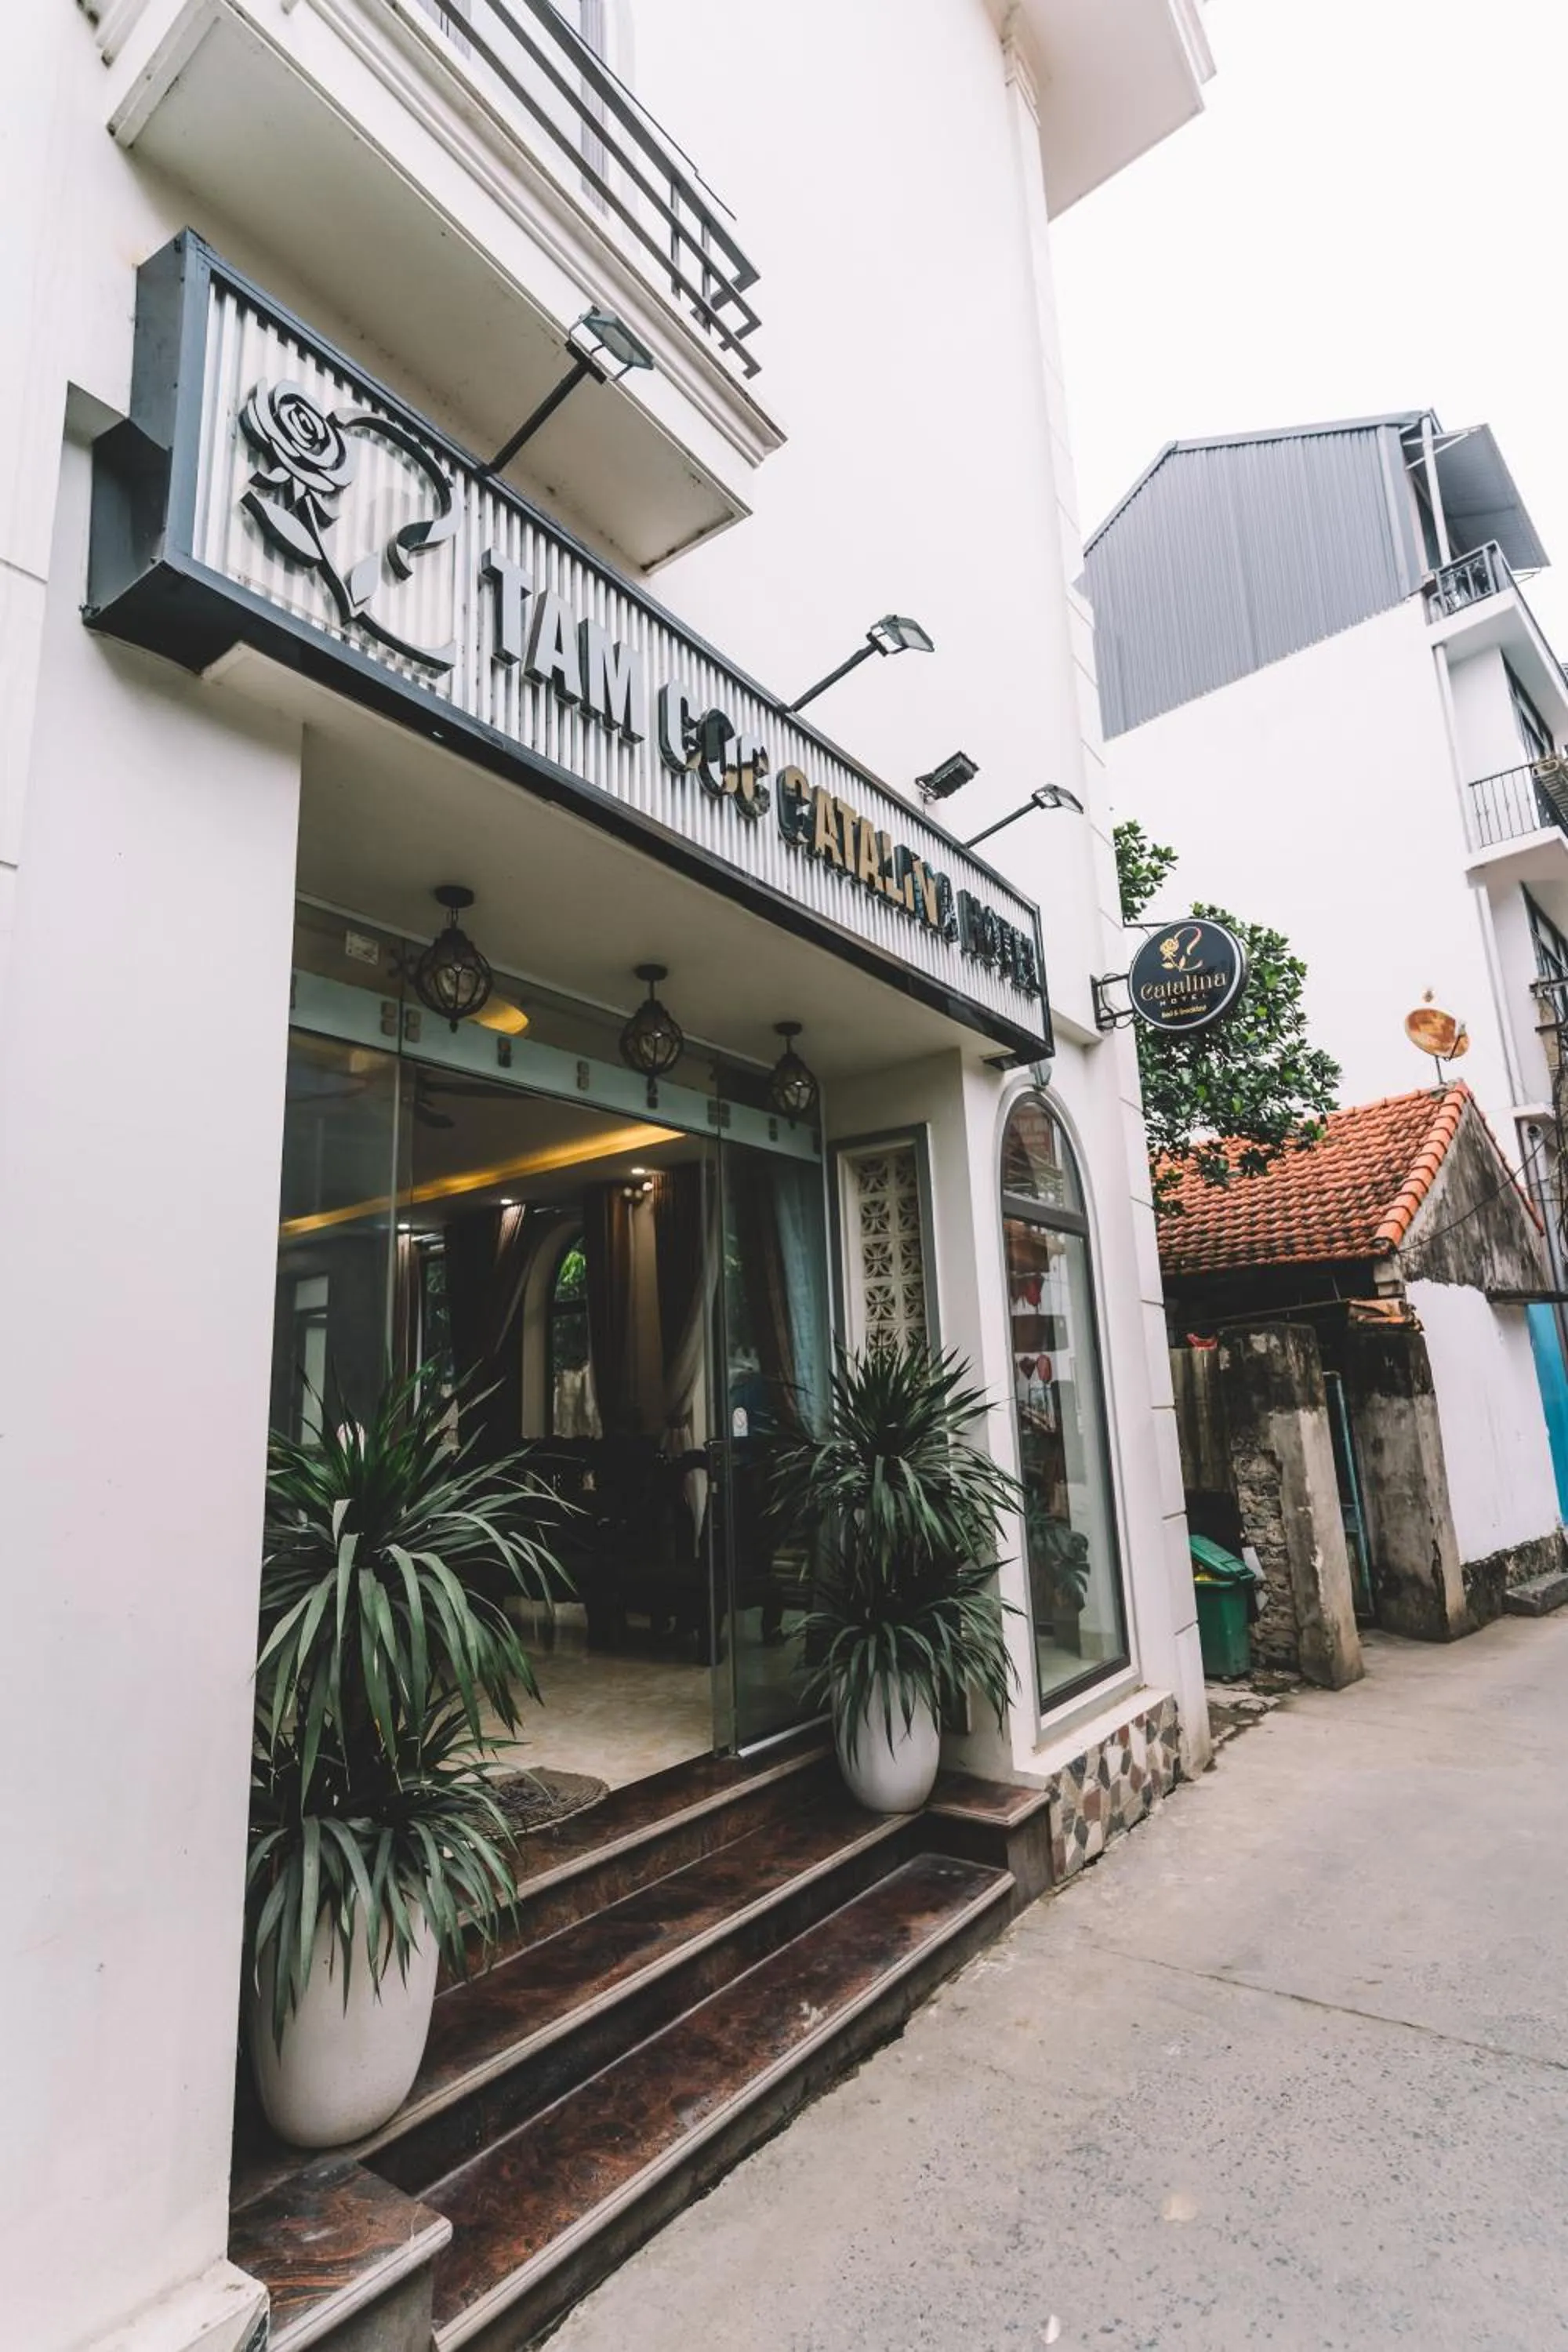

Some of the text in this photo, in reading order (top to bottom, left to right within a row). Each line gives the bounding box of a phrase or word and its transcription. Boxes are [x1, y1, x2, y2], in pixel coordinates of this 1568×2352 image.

[481, 548, 644, 743] TAM
[659, 679, 771, 820] COC
[777, 765, 959, 943] CATALINA
[1141, 974, 1226, 1000] Catalina
[1160, 993, 1208, 1007] HOTEL
